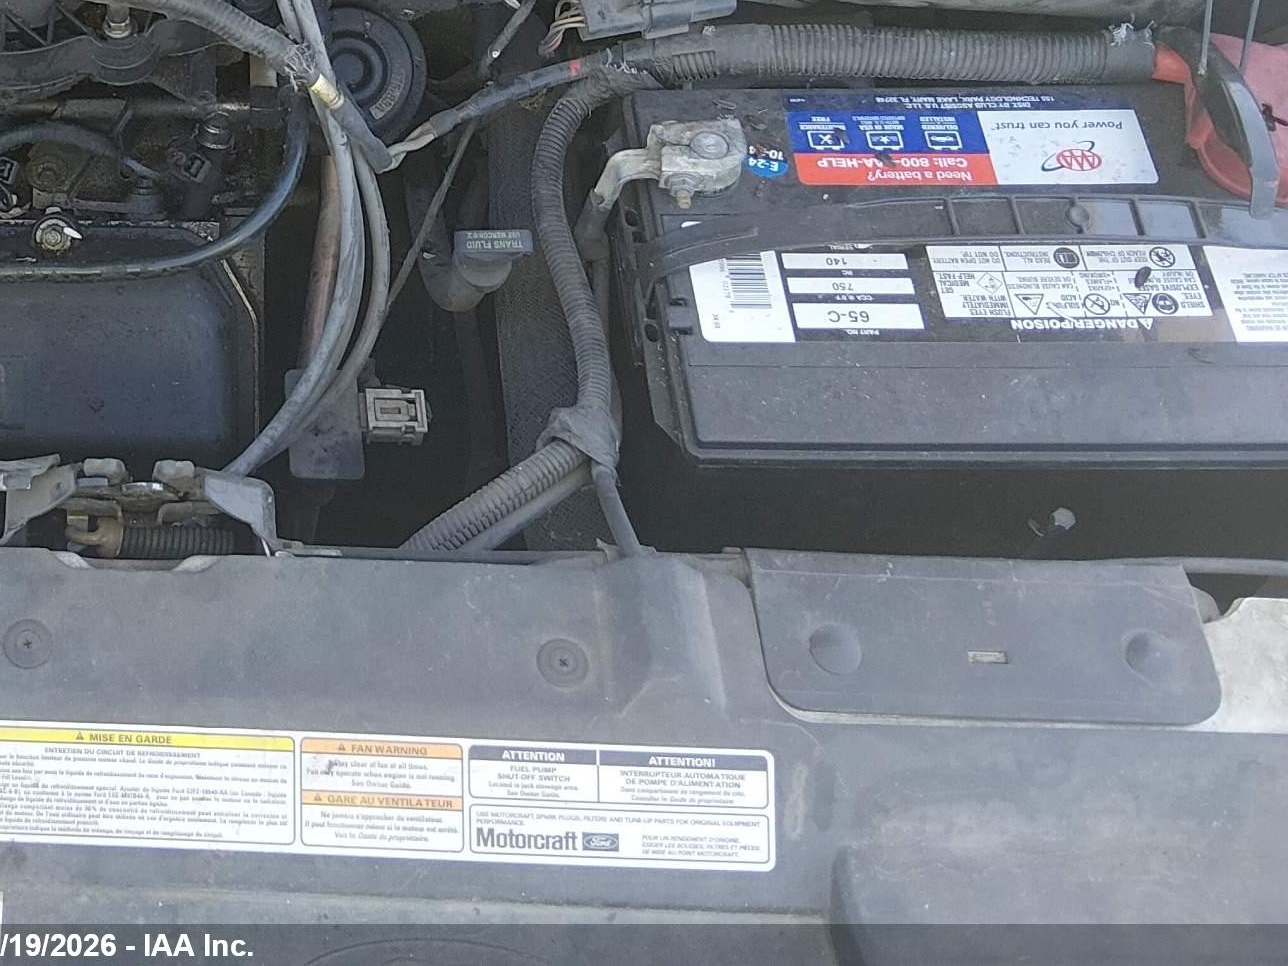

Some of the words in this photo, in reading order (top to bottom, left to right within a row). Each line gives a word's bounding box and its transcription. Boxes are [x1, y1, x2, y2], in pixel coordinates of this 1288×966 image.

[1054, 120, 1078, 128] you
[1082, 121, 1122, 130] Power
[817, 157, 928, 168] 800-AA-HELP
[932, 157, 967, 168] Call:
[1061, 150, 1100, 170] AAA
[867, 169, 921, 181] battery?
[924, 171, 934, 179] a
[936, 170, 972, 181] Need
[466, 240, 492, 249] FLUID
[494, 240, 522, 248] TRANS
[826, 258, 848, 266] 140
[832, 282, 854, 290] 750
[828, 310, 870, 323] 65-C
[1010, 318, 1138, 330] DANGER/POISON
[89, 734, 115, 742] MISE
[118, 734, 132, 742] EN
[136, 735, 172, 744] GARDE
[351, 744, 374, 753] FAN
[376, 746, 428, 756] WARNING
[502, 750, 565, 762] ATTENTION
[648, 756, 716, 767] ATTENTION!
[620, 770, 682, 778] INTERRUPTEUR
[684, 772, 745, 780] AUTOMATIQUE
[327, 794, 358, 803] GARE
[360, 796, 375, 804] AU
[378, 797, 453, 808] VENTILATEUR
[476, 827, 578, 850] Motorcraft
